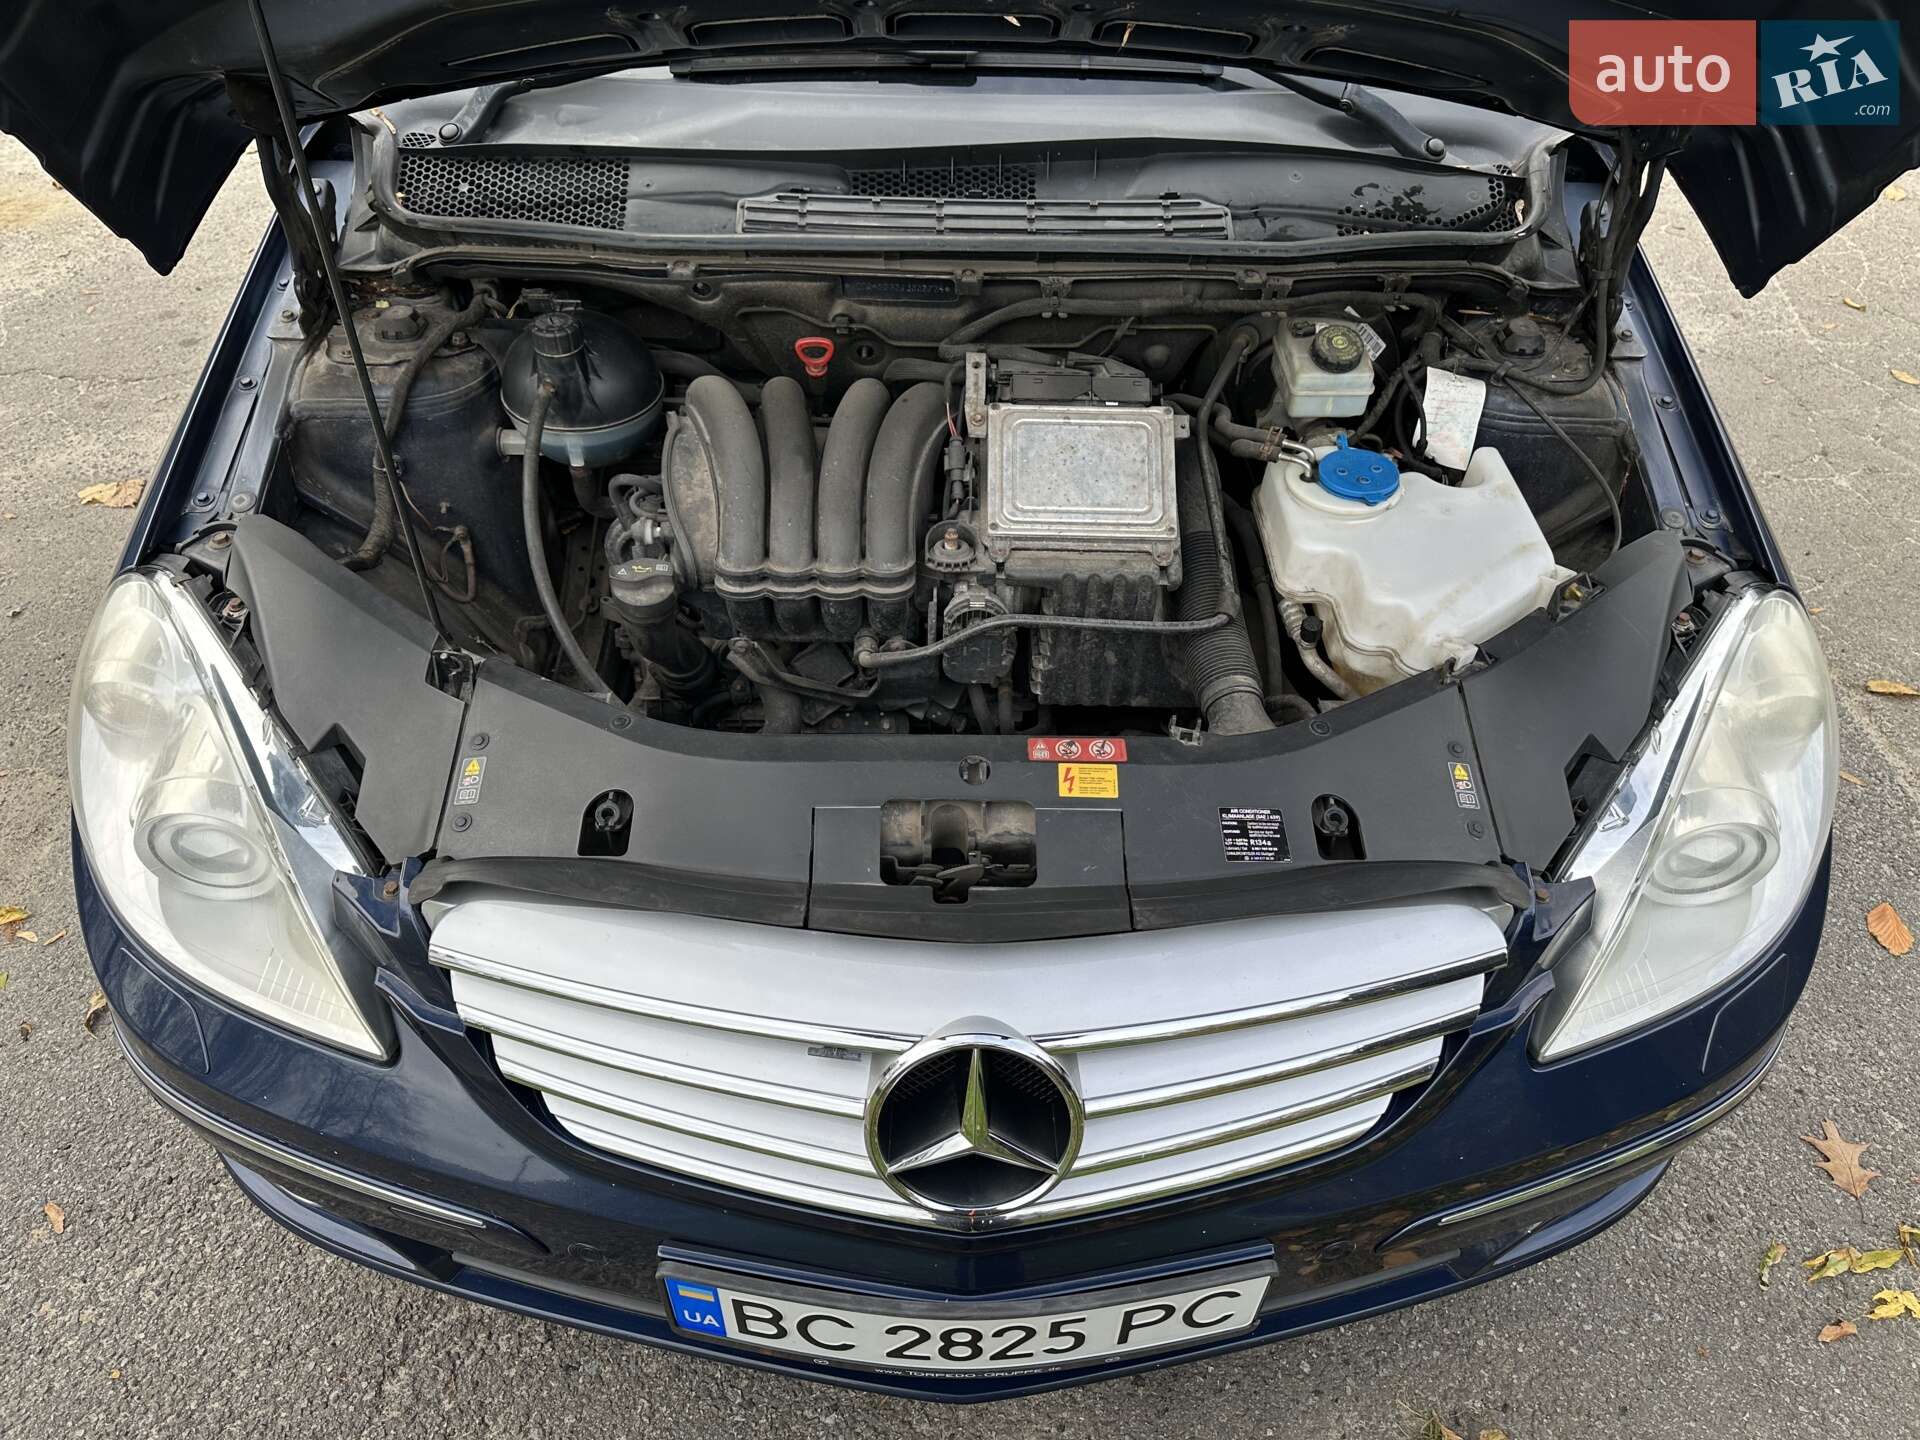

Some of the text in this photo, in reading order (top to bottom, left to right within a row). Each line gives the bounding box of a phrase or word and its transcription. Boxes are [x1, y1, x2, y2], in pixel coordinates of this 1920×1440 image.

[683, 1308, 720, 1328] UA
[730, 1290, 1243, 1363] BC 2825 PC
